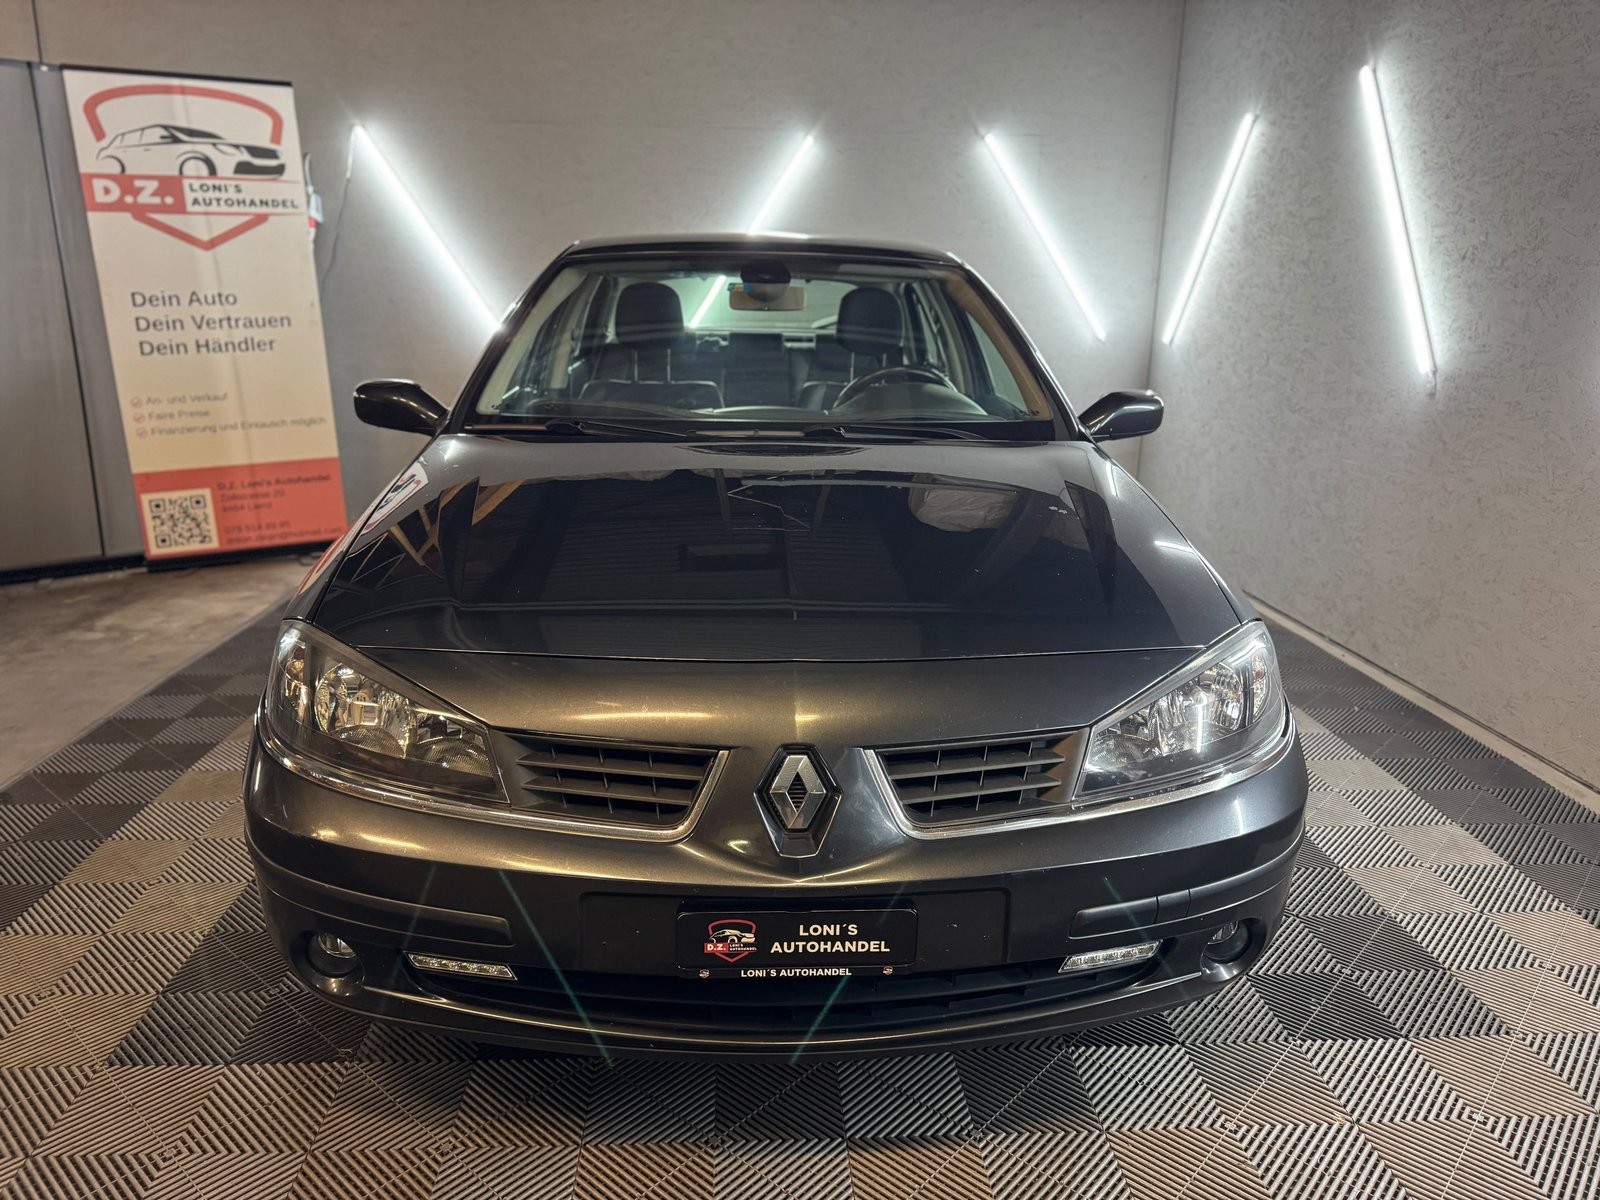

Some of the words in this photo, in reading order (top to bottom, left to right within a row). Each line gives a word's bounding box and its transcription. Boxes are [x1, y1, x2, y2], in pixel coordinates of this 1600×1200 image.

[91, 178, 175, 205] D.Z.
[191, 197, 299, 209] AUTOHANDEL
[131, 290, 181, 307] Dein
[188, 291, 238, 306] Auto
[135, 315, 185, 332] Dein
[191, 314, 292, 330] Vertrauen
[139, 339, 188, 356] Dein
[195, 337, 277, 353] Händler
[190, 392, 228, 403] Verkauf
[148, 412, 175, 420] Faire
[177, 409, 210, 418] Preise
[151, 424, 217, 436] Finanzierung
[219, 423, 239, 431] und
[241, 419, 288, 430] Eintausch
[290, 416, 327, 427] möglich
[770, 940, 890, 954] AUTOHANDEL
[779, 967, 852, 977] AUTOHANDEL
